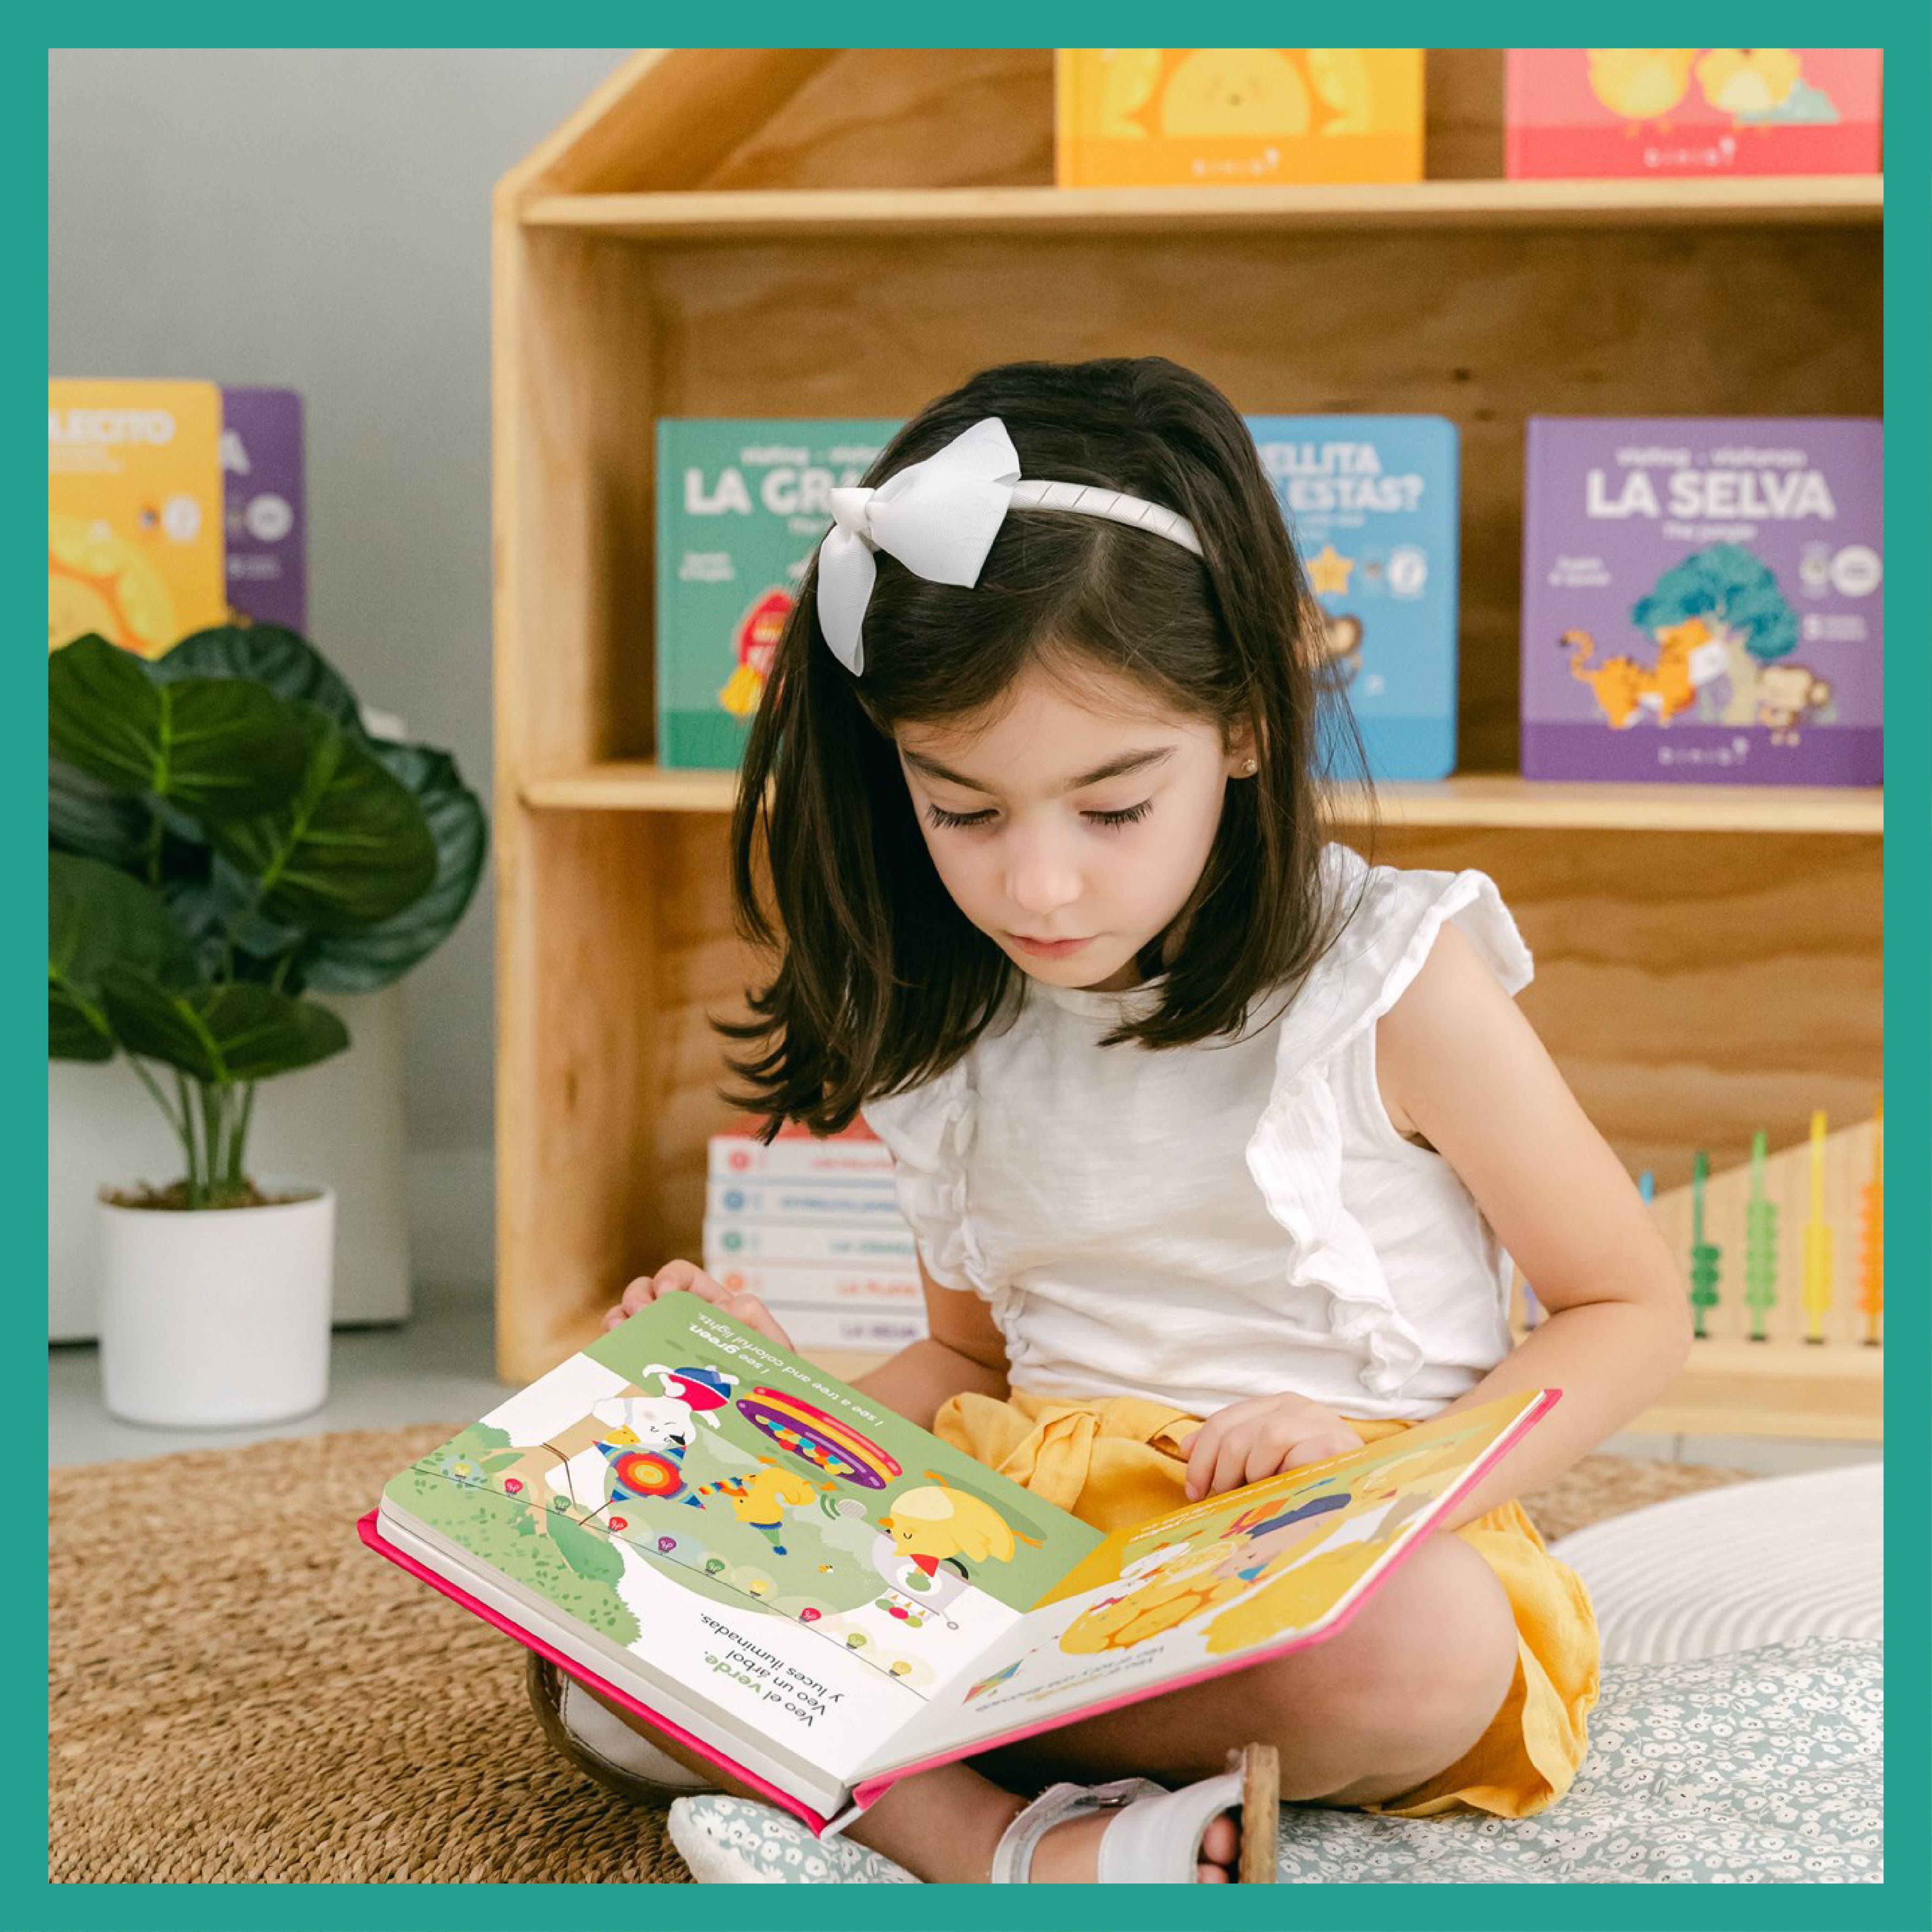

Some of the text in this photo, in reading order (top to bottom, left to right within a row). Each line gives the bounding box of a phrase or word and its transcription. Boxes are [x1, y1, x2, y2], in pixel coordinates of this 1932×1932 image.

[683, 467, 752, 515] LA
[1586, 468, 1836, 520] LA SELVA
[731, 1335, 784, 1367] colorful
[739, 1354, 764, 1369] see
[782, 1366, 811, 1383] and
[812, 1383, 840, 1400] tree
[851, 1405, 877, 1422] see
[700, 1613, 844, 1702] y luces iluminadas.
[704, 1651, 813, 1727] Veo el verde.
[725, 1650, 826, 1716] Veo un árbol
